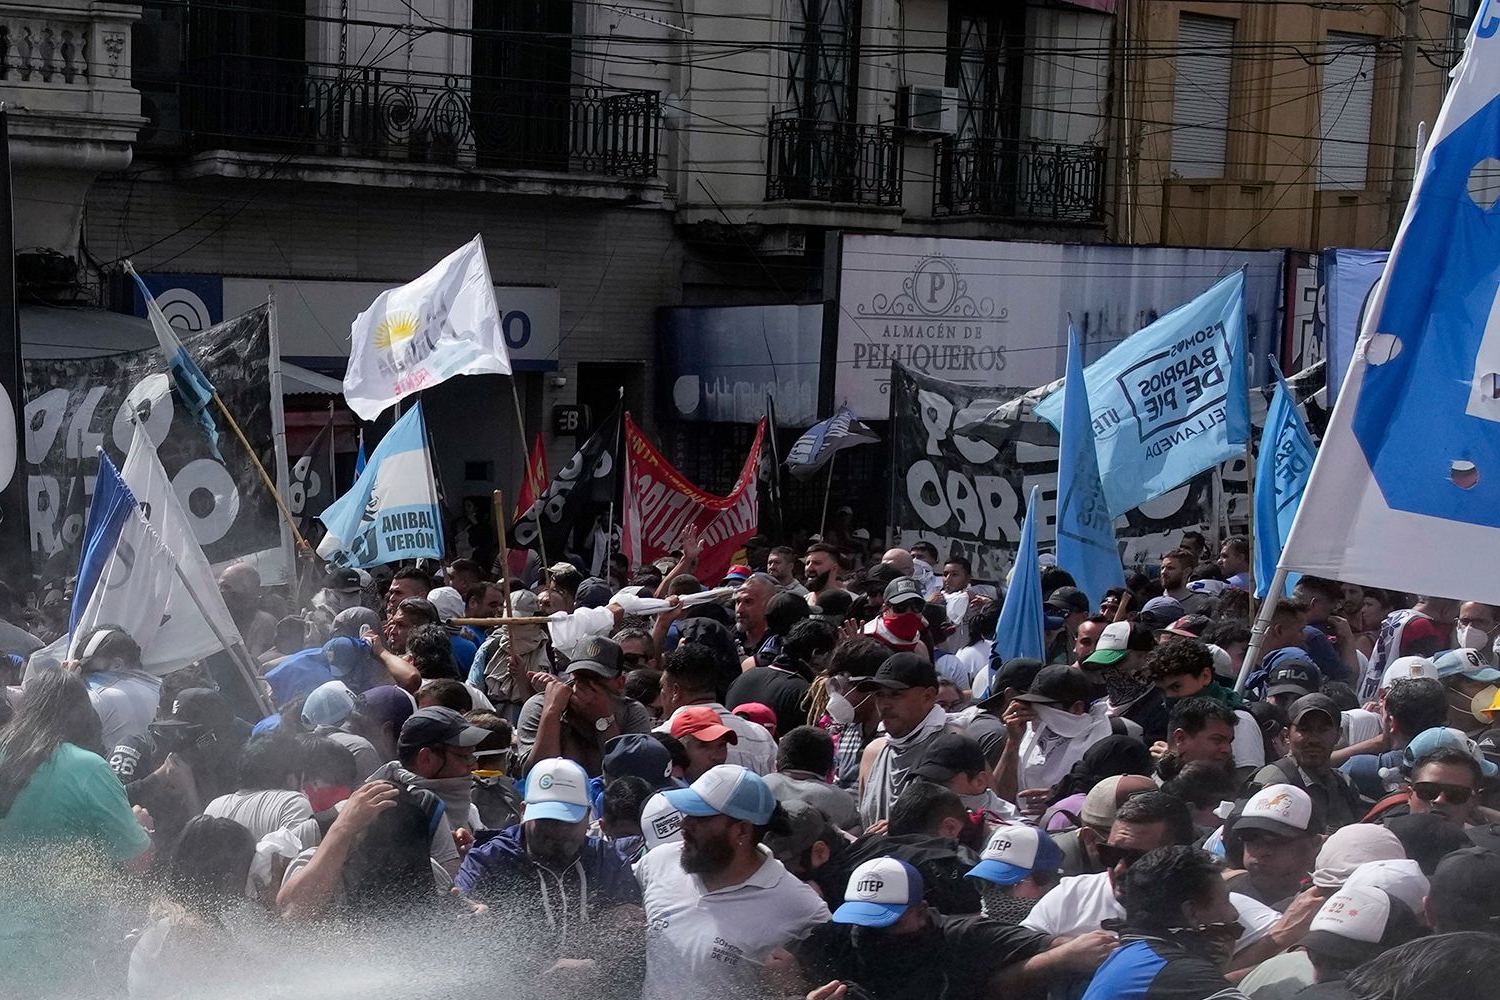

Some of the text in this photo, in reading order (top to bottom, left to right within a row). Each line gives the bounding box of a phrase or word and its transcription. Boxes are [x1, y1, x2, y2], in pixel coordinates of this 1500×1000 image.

[882, 323, 983, 339] ALMACÉN DE
[852, 343, 1008, 375] PELUQUEROS
[382, 511, 434, 533] ANIBAL
[386, 529, 436, 553] VERÓN
[1277, 669, 1309, 681] FILA
[657, 826, 669, 835] DE
[857, 880, 884, 892] UTEP
